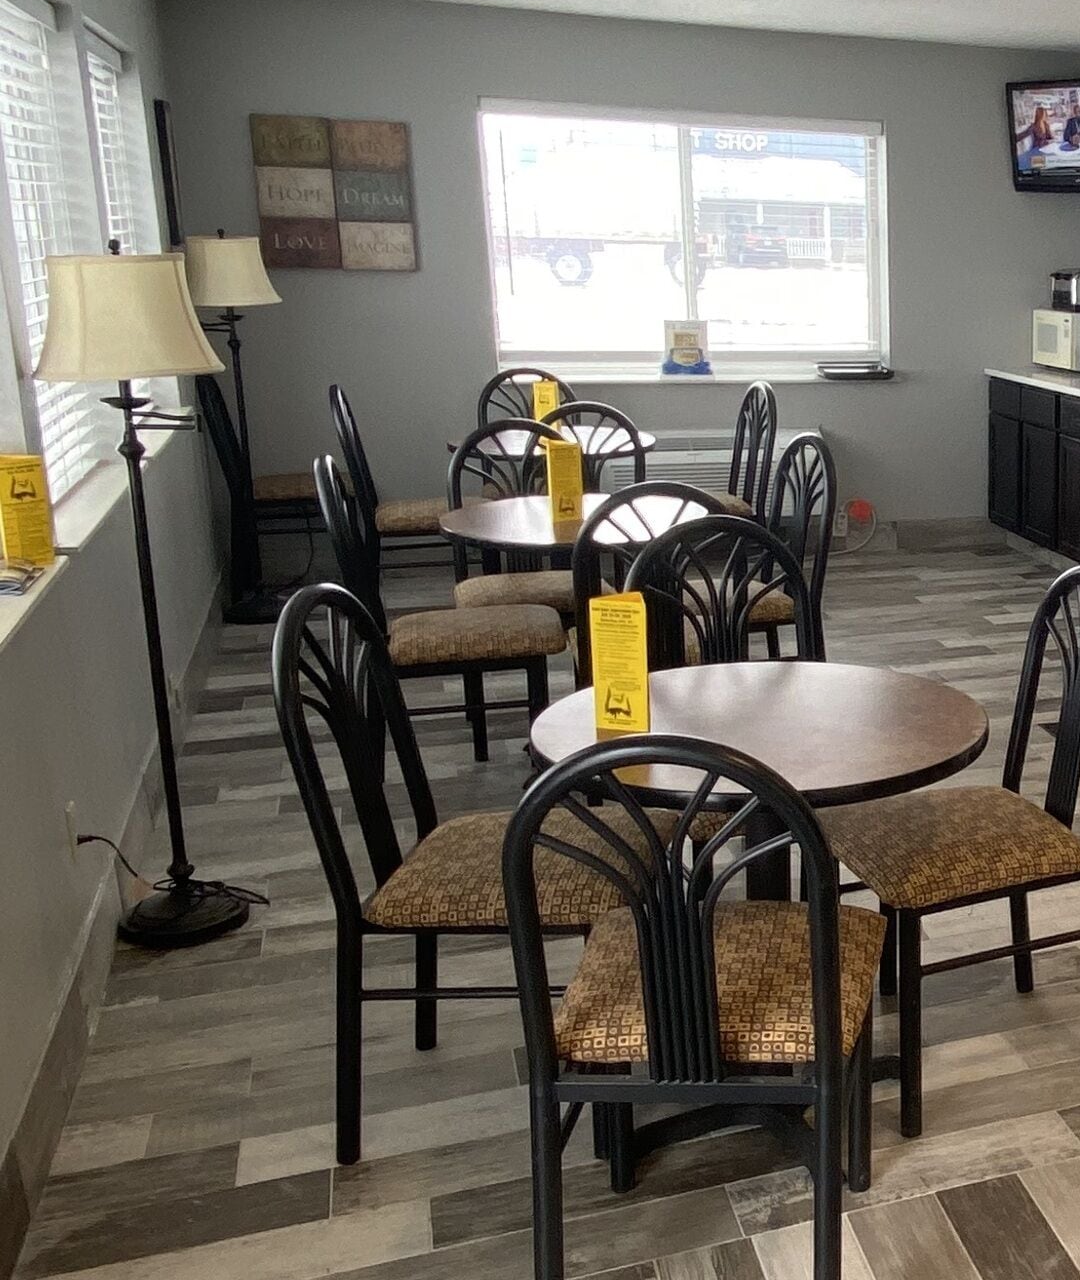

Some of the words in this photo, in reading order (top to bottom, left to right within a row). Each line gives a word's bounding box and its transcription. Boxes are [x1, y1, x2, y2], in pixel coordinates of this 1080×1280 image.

[714, 131, 769, 152] SHOP
[267, 184, 324, 203] HOPE
[342, 187, 405, 208] DREAM
[273, 232, 328, 251] LOVE
[347, 239, 410, 256] IMAGINE
